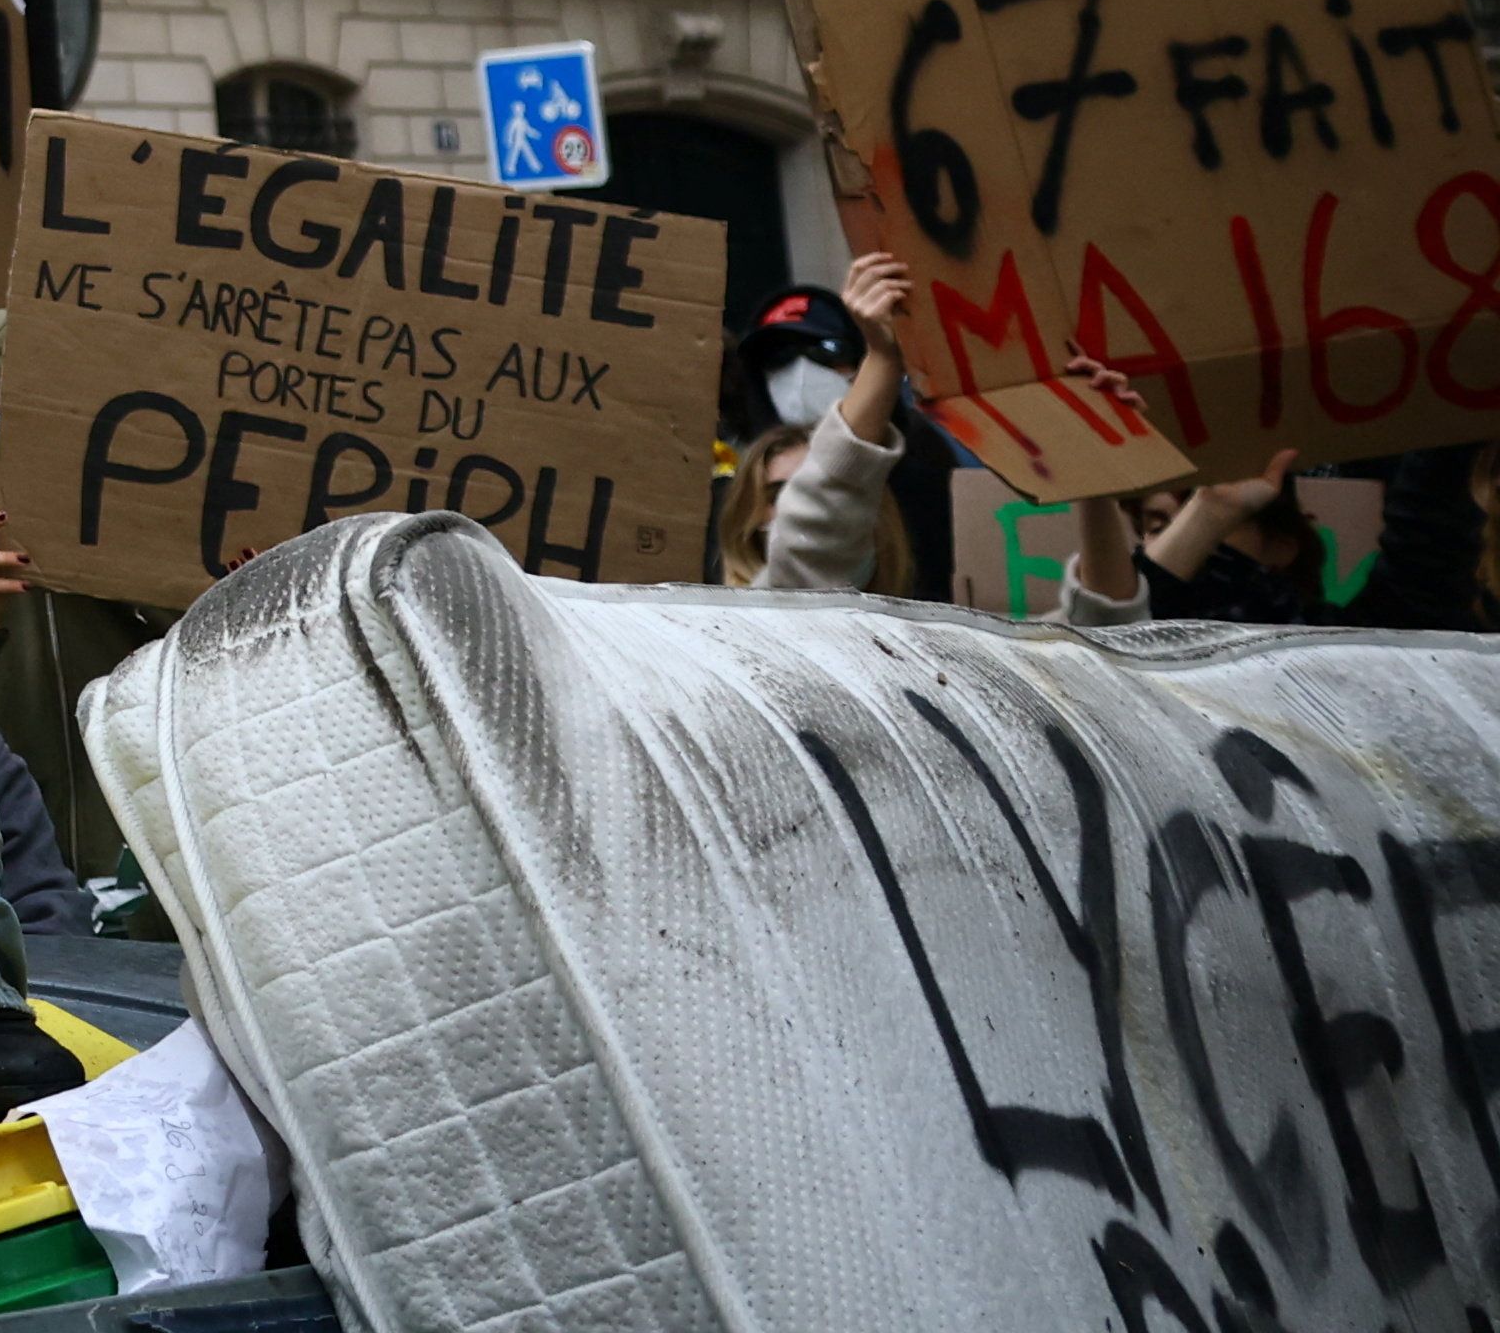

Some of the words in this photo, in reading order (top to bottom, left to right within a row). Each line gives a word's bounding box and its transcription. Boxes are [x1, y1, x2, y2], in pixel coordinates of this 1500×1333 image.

[34, 259, 112, 312] NE
[137, 271, 352, 361] S'ARRÊTE
[356, 314, 462, 380] PAS
[485, 341, 610, 411] AUX
[217, 349, 387, 425] PORTES
[417, 388, 487, 441] DU
